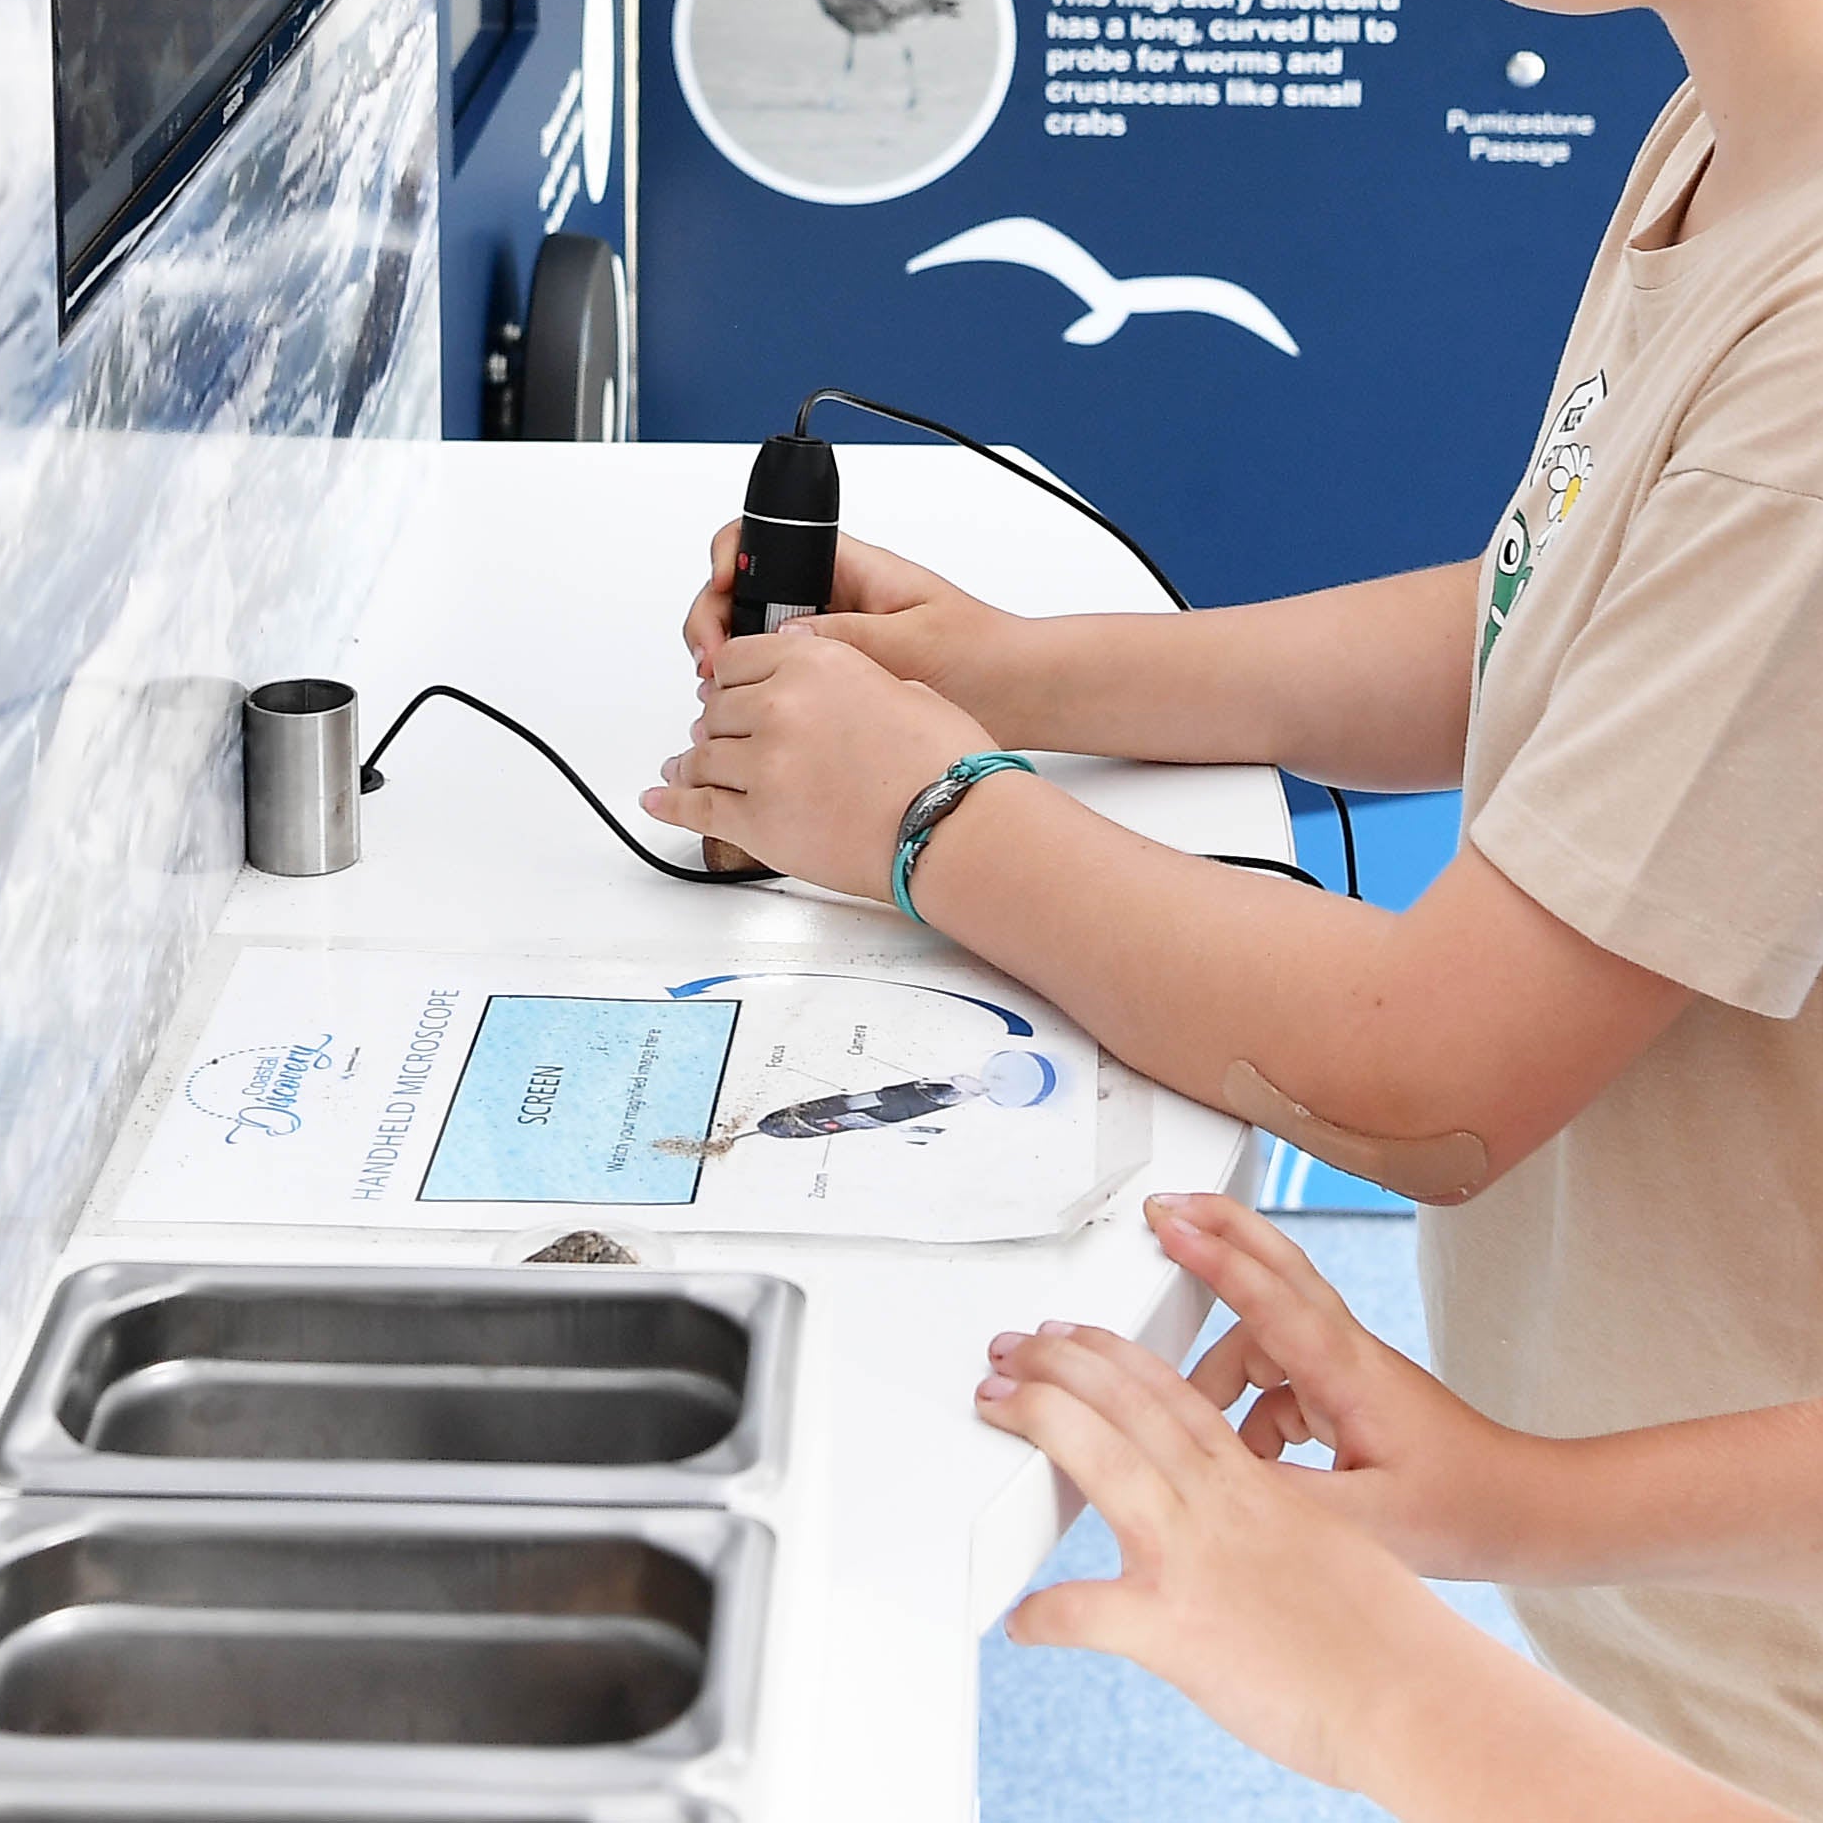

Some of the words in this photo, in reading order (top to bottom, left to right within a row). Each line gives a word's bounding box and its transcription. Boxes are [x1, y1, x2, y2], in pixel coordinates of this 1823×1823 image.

[1045, 10, 1102, 41] has
[1104, 15, 1127, 42] a
[1129, 11, 1205, 48] long,
[1207, 13, 1311, 44] curved
[1313, 14, 1362, 45] bill
[1364, 15, 1398, 45] to
[1045, 43, 1132, 78] probe
[1135, 43, 1181, 74] for
[1182, 49, 1284, 76] worms
[1285, 46, 1345, 77] and
[1044, 77, 1222, 108] crustaceans
[1224, 77, 1280, 108] like
[1282, 79, 1363, 109] small
[1043, 107, 1128, 138] crabs
[1468, 135, 1572, 169] Passage
[638, 1027, 662, 1048] here
[846, 1024, 868, 1056] Camera
[764, 1044, 786, 1068] Focus
[225, 1033, 333, 1145] Discovery
[241, 1055, 281, 1096] Coastal
[351, 1100, 417, 1202] HANDHELD
[391, 988, 461, 1096] MICROSCOPE
[516, 1064, 565, 1126] SCREEN
[617, 1121, 637, 1143] your
[605, 1143, 630, 1173] Watch
[807, 1171, 830, 1200] Zoom
